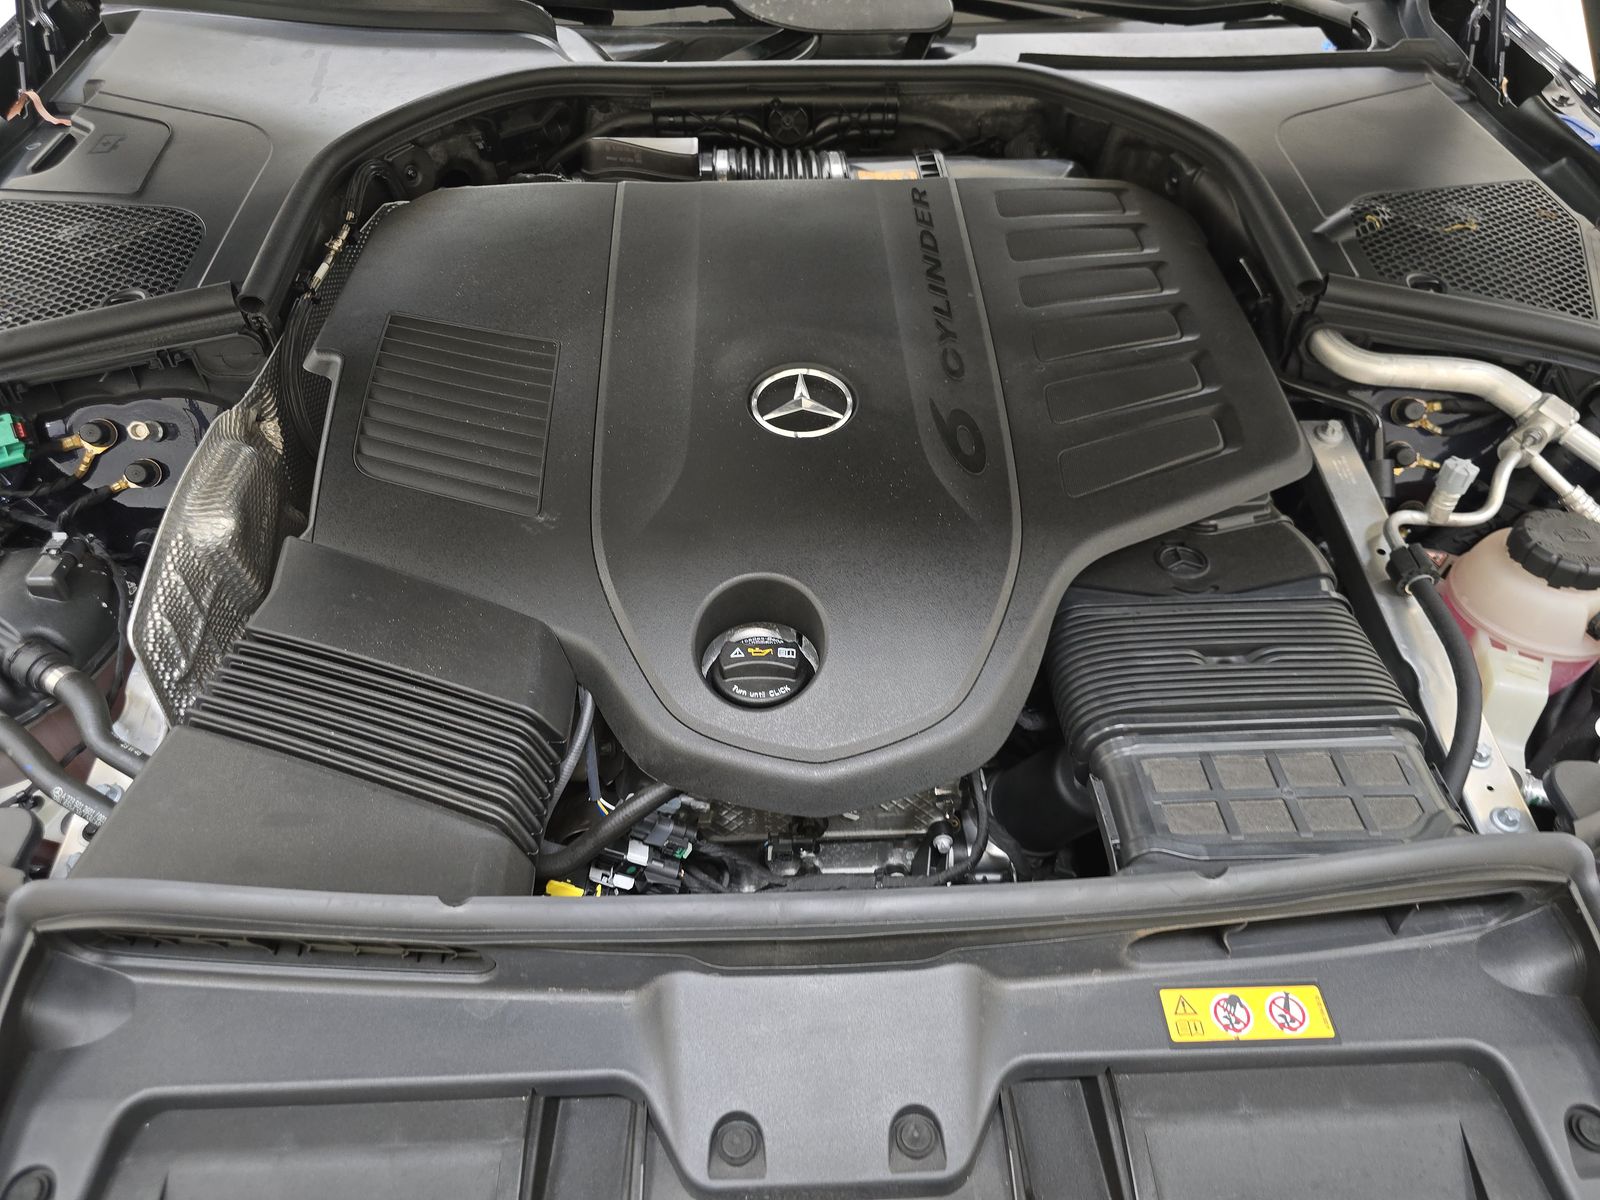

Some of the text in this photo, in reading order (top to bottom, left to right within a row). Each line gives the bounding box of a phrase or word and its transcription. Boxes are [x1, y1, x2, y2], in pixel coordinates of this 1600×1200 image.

[911, 186, 987, 477] 6 CYLINDER
[732, 684, 791, 699] Turn until CLICK
